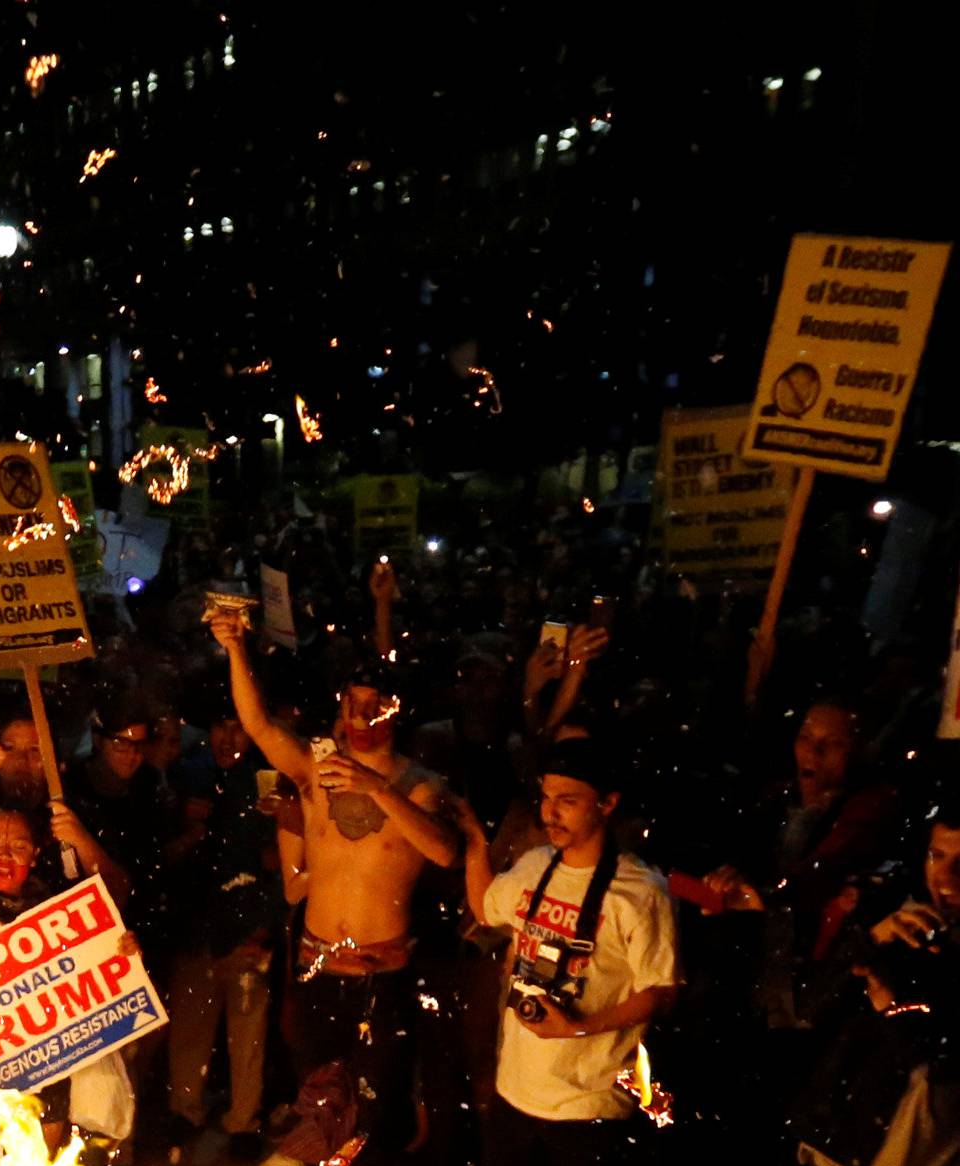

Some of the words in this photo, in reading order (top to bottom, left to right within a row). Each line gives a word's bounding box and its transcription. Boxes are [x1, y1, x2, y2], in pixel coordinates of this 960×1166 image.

[837, 246, 916, 273] Resistir
[835, 364, 894, 392] Guerra
[823, 397, 896, 427] Racismo
[675, 454, 733, 477] STRET
[0, 582, 28, 602] OR
[63, 990, 149, 1050] RESISTANCE
